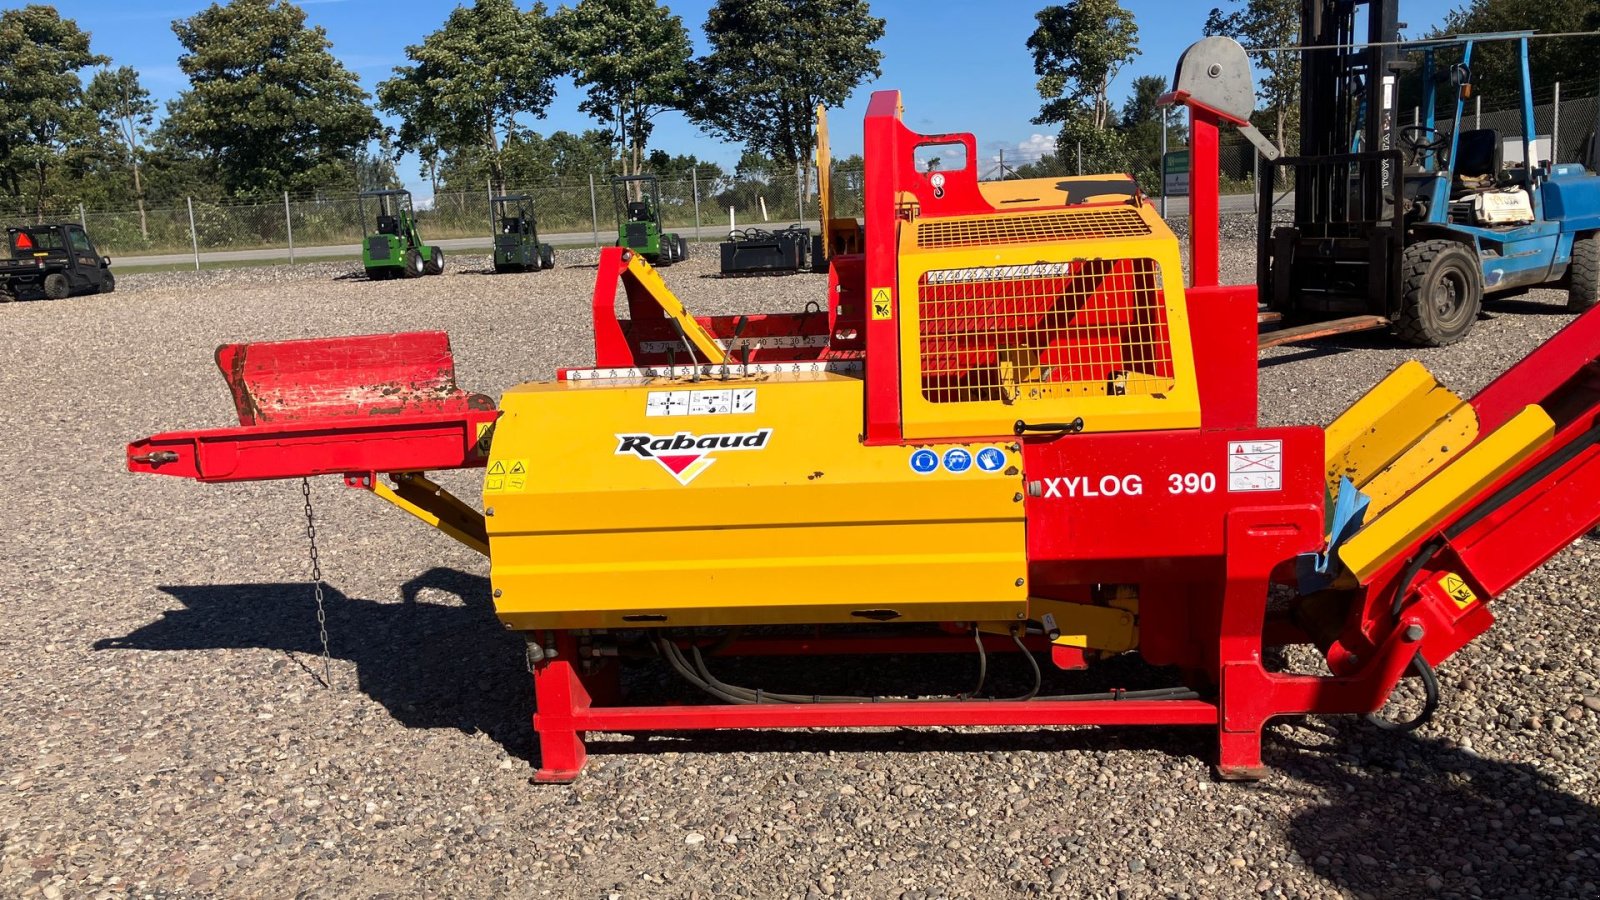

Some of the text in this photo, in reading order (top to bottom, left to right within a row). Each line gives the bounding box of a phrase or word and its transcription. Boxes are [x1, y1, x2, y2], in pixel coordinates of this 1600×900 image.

[1381, 133, 1391, 189] TOYTA
[609, 369, 618, 378] 75
[627, 369, 636, 377] 70
[681, 367, 691, 375] 55
[755, 365, 764, 373] 35
[810, 364, 819, 372] 20
[619, 431, 768, 457] Rabaud
[1044, 472, 1216, 498] XYLOG 390
